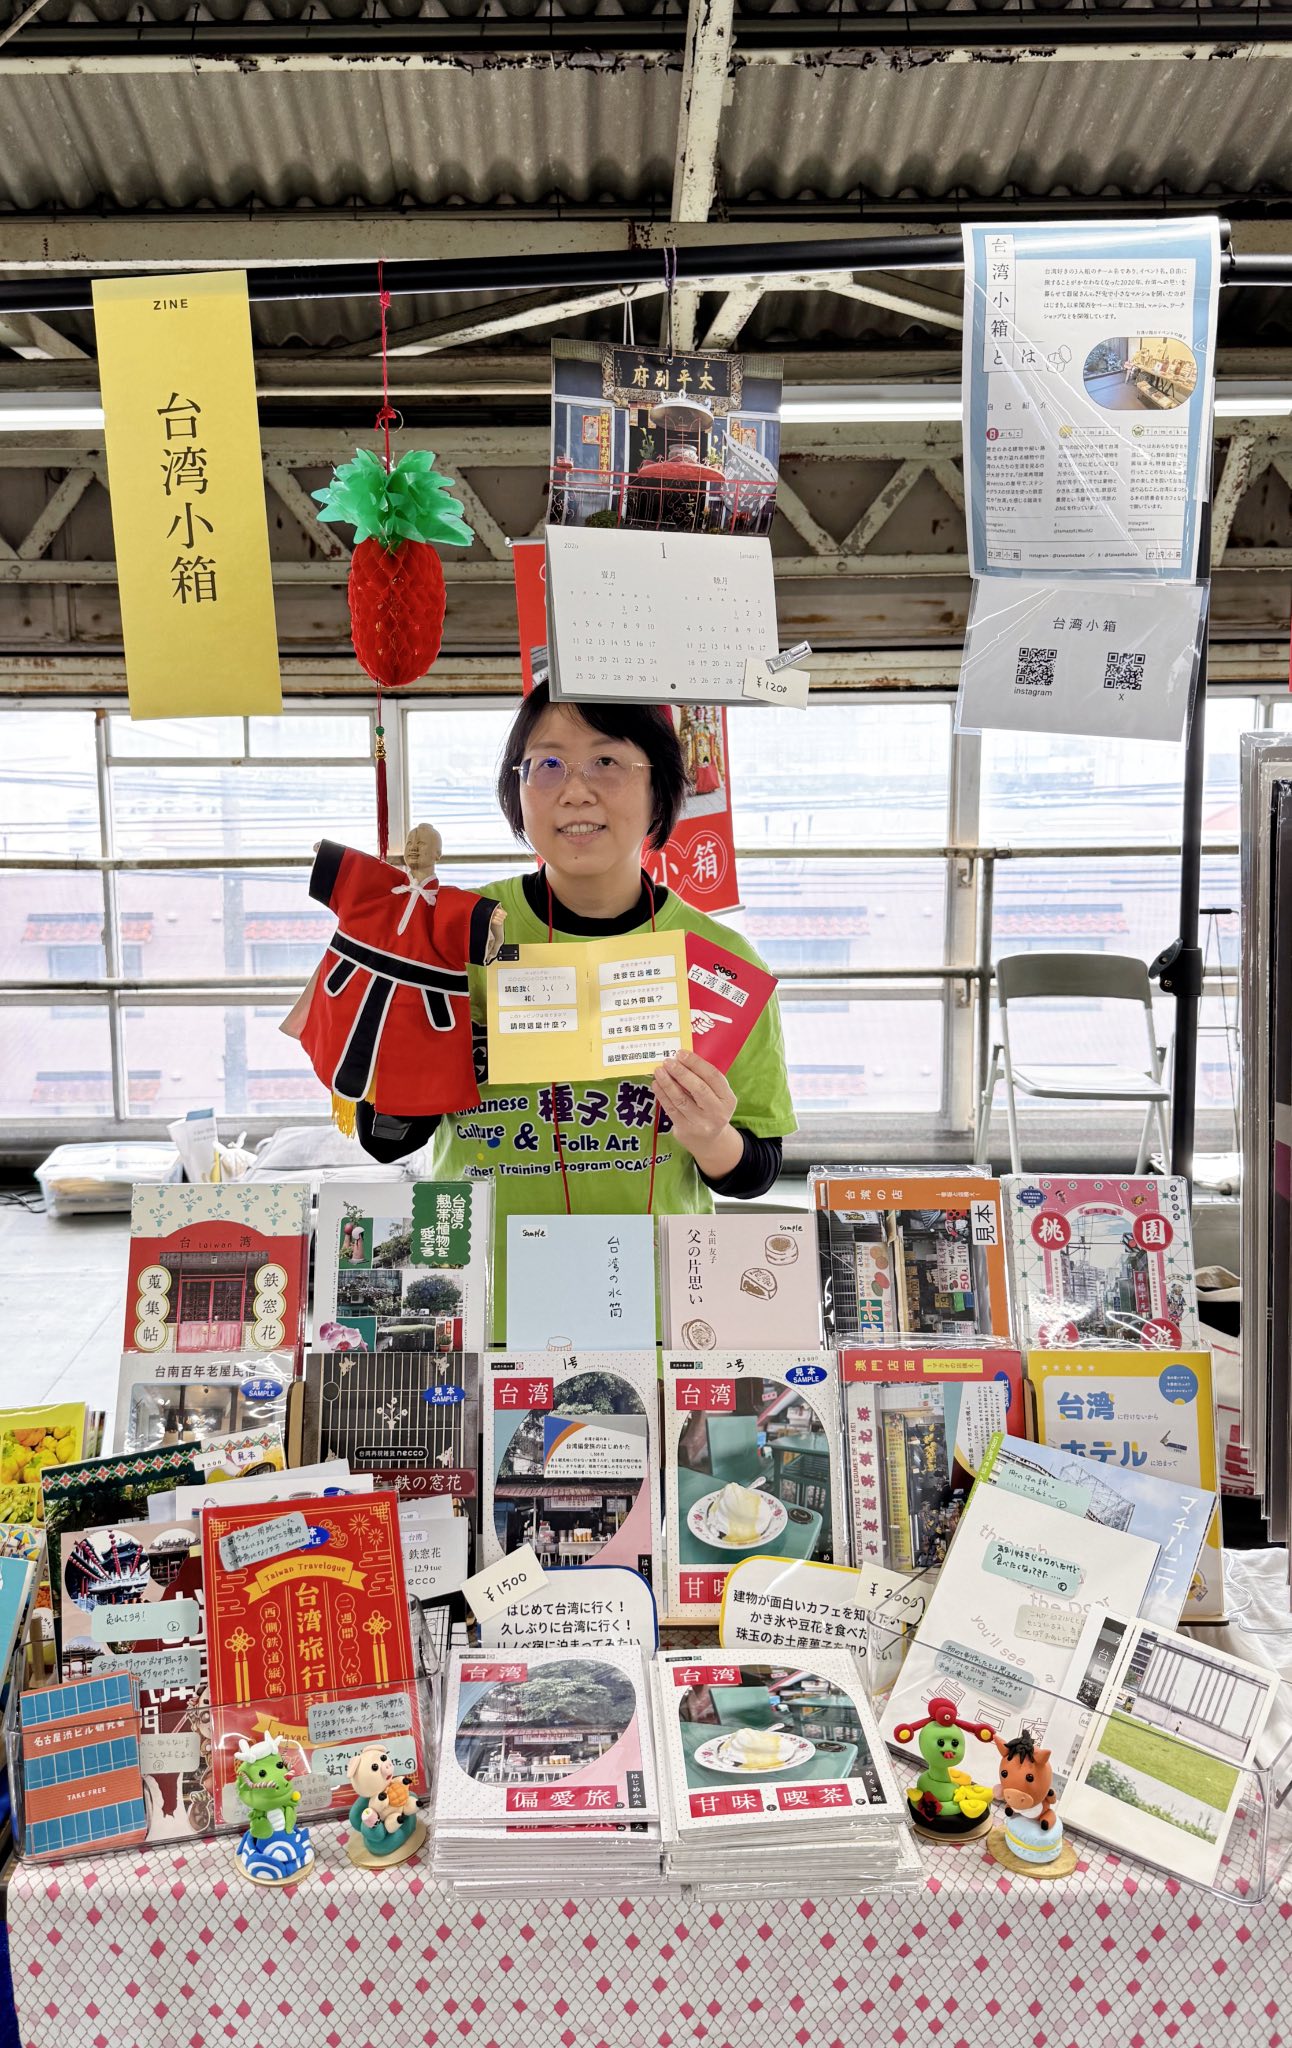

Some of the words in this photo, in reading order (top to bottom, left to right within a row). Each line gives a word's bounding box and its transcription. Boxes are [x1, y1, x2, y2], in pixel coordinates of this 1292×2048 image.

[152, 299, 189, 311] ZINE
[157, 391, 218, 605] 台湾小箱
[661, 542, 668, 559] 1
[1052, 617, 1118, 633] 台湾小箱
[755, 675, 788, 694] ¥1200
[1013, 686, 1053, 697] instagram
[1118, 693, 1125, 701] X
[652, 840, 719, 885] 小箱
[690, 967, 747, 1006] 台湾華語
[538, 1081, 672, 1134] 種子教
[456, 1122, 506, 1140] Culture
[514, 1122, 539, 1151] &
[552, 1133, 600, 1153] Folk
[605, 1133, 640, 1152] Art
[499, 1164, 551, 1176] Training
[554, 1160, 611, 1173] Program
[451, 1193, 467, 1230] 台湾の
[974, 1204, 997, 1244] 見本
[1037, 1217, 1065, 1243] 桃
[1141, 1218, 1166, 1245] 園
[179, 1237, 191, 1249] 台
[198, 1241, 233, 1249] taiwan
[239, 1235, 252, 1249] 湾
[420, 1225, 435, 1258] 愛でる
[687, 1228, 703, 1305] 父の片思い
[606, 1235, 623, 1319] 台湾の水筒
[142, 1273, 162, 1342] 蒐集帖
[261, 1272, 280, 1341] 鉄窓花
[725, 1358, 746, 1373] 2号
[796, 1366, 816, 1377] 見本
[252, 1380, 273, 1390] 見本
[793, 1376, 820, 1384] SAMPLE
[248, 1389, 276, 1397] SAMPLE
[431, 1395, 458, 1403] SAMPLE
[434, 1387, 456, 1396] 見本
[499, 1382, 549, 1405] 台湾
[681, 1383, 731, 1406] 台湾
[1057, 1391, 1115, 1421] 台湾
[396, 1449, 424, 1457] necco
[1060, 1440, 1148, 1467] ホテル
[394, 1474, 463, 1492] 鉄の窓花
[408, 1547, 441, 1560] 鉄窓花
[264, 1565, 294, 1582] Taiwan
[297, 1562, 346, 1573] Travelogue
[407, 1576, 436, 1586] ecco
[483, 1572, 527, 1603] ¥1500
[507, 1600, 625, 1617] はじめて台湾に行く！
[1030, 1592, 1061, 1611] the
[500, 1619, 632, 1636] 久しぶりに台湾に行く！
[970, 1615, 1003, 1648] you'll
[1000, 1647, 1027, 1667] see
[467, 1665, 522, 1680] 台湾
[679, 1667, 736, 1683] 台湾
[33, 1716, 126, 1748] 名古屋渋ビル研究会
[67, 1790, 86, 1801] TAKE
[88, 1786, 107, 1797] FREE
[511, 1789, 612, 1808] 偏愛旅
[631, 1772, 643, 1806] はじめかた
[695, 1792, 757, 1814] 甘味
[783, 1787, 845, 1806] 喫茶
